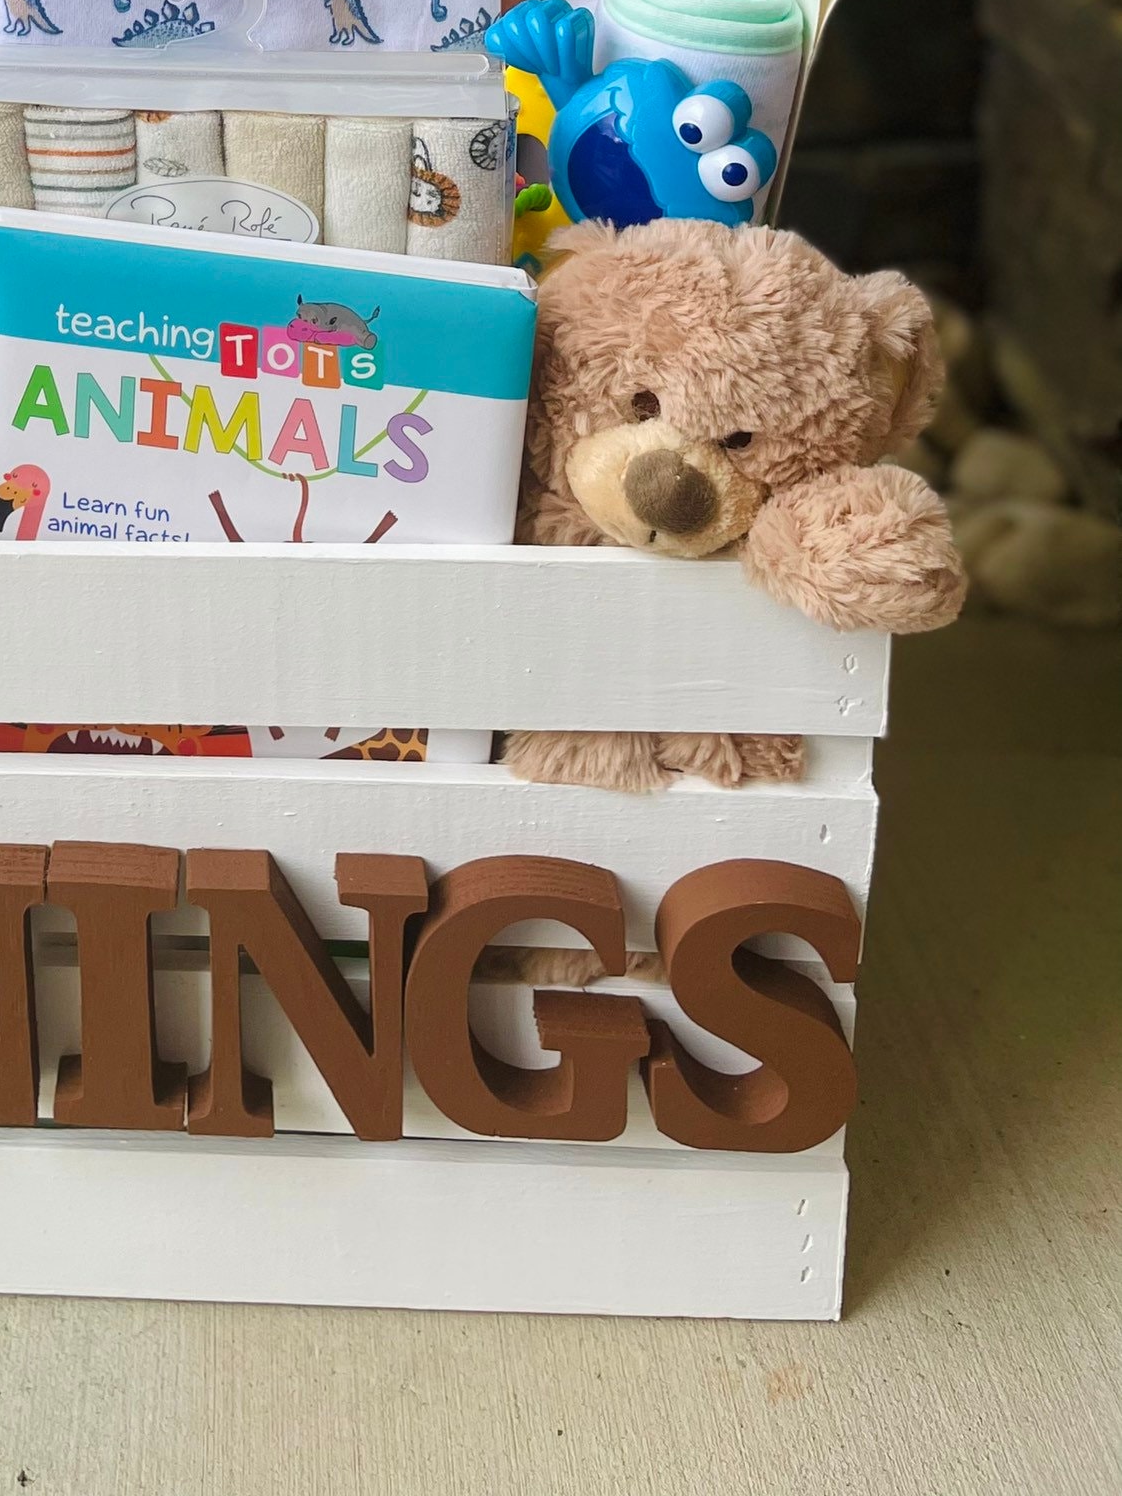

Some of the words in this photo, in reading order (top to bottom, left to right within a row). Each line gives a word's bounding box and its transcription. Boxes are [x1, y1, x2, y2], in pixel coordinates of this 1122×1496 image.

[56, 304, 215, 359] teaching
[224, 332, 377, 381] TOTS
[12, 365, 434, 483] ANIMALS
[47, 515, 118, 540] animal
[62, 492, 127, 517] Learn
[135, 500, 170, 523] fun
